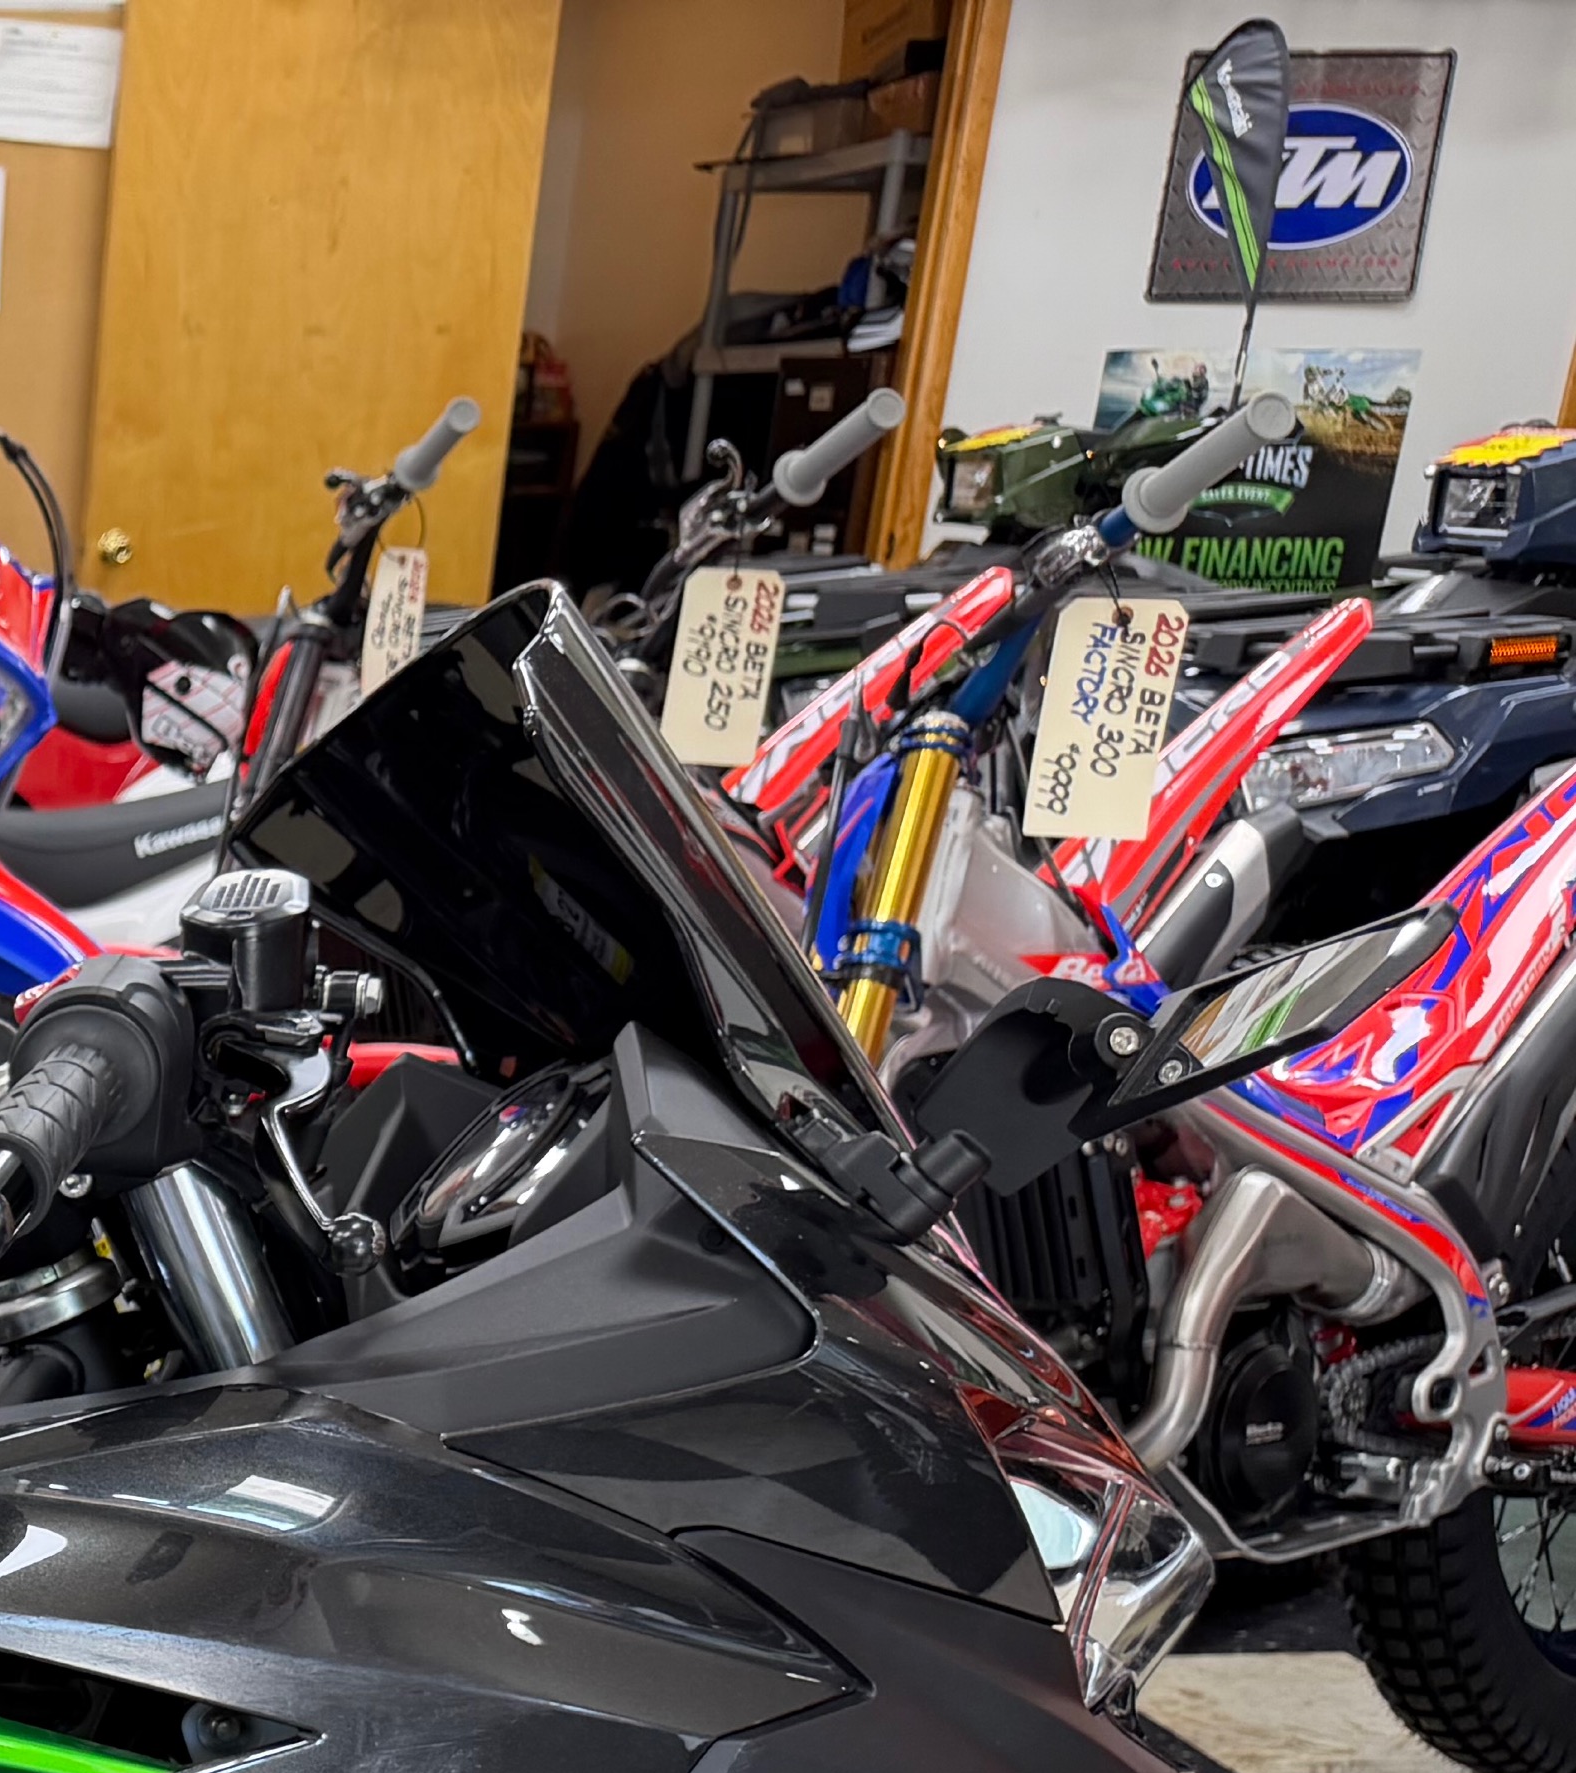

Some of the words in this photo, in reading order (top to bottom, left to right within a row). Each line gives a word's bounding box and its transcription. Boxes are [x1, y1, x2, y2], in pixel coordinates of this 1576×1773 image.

[1201, 136, 1402, 209] TM
[1244, 446, 1313, 489] TIMES
[1181, 536, 1345, 579] FINANCING
[715, 595, 748, 675] SINCRO
[1144, 612, 1185, 679] 2026
[737, 641, 768, 701] BETA
[1070, 622, 1118, 726] FACTORY
[1104, 631, 1146, 715] SINCRO
[704, 679, 734, 733] 250
[1126, 687, 1167, 756] BETA
[1089, 722, 1125, 779] 300
